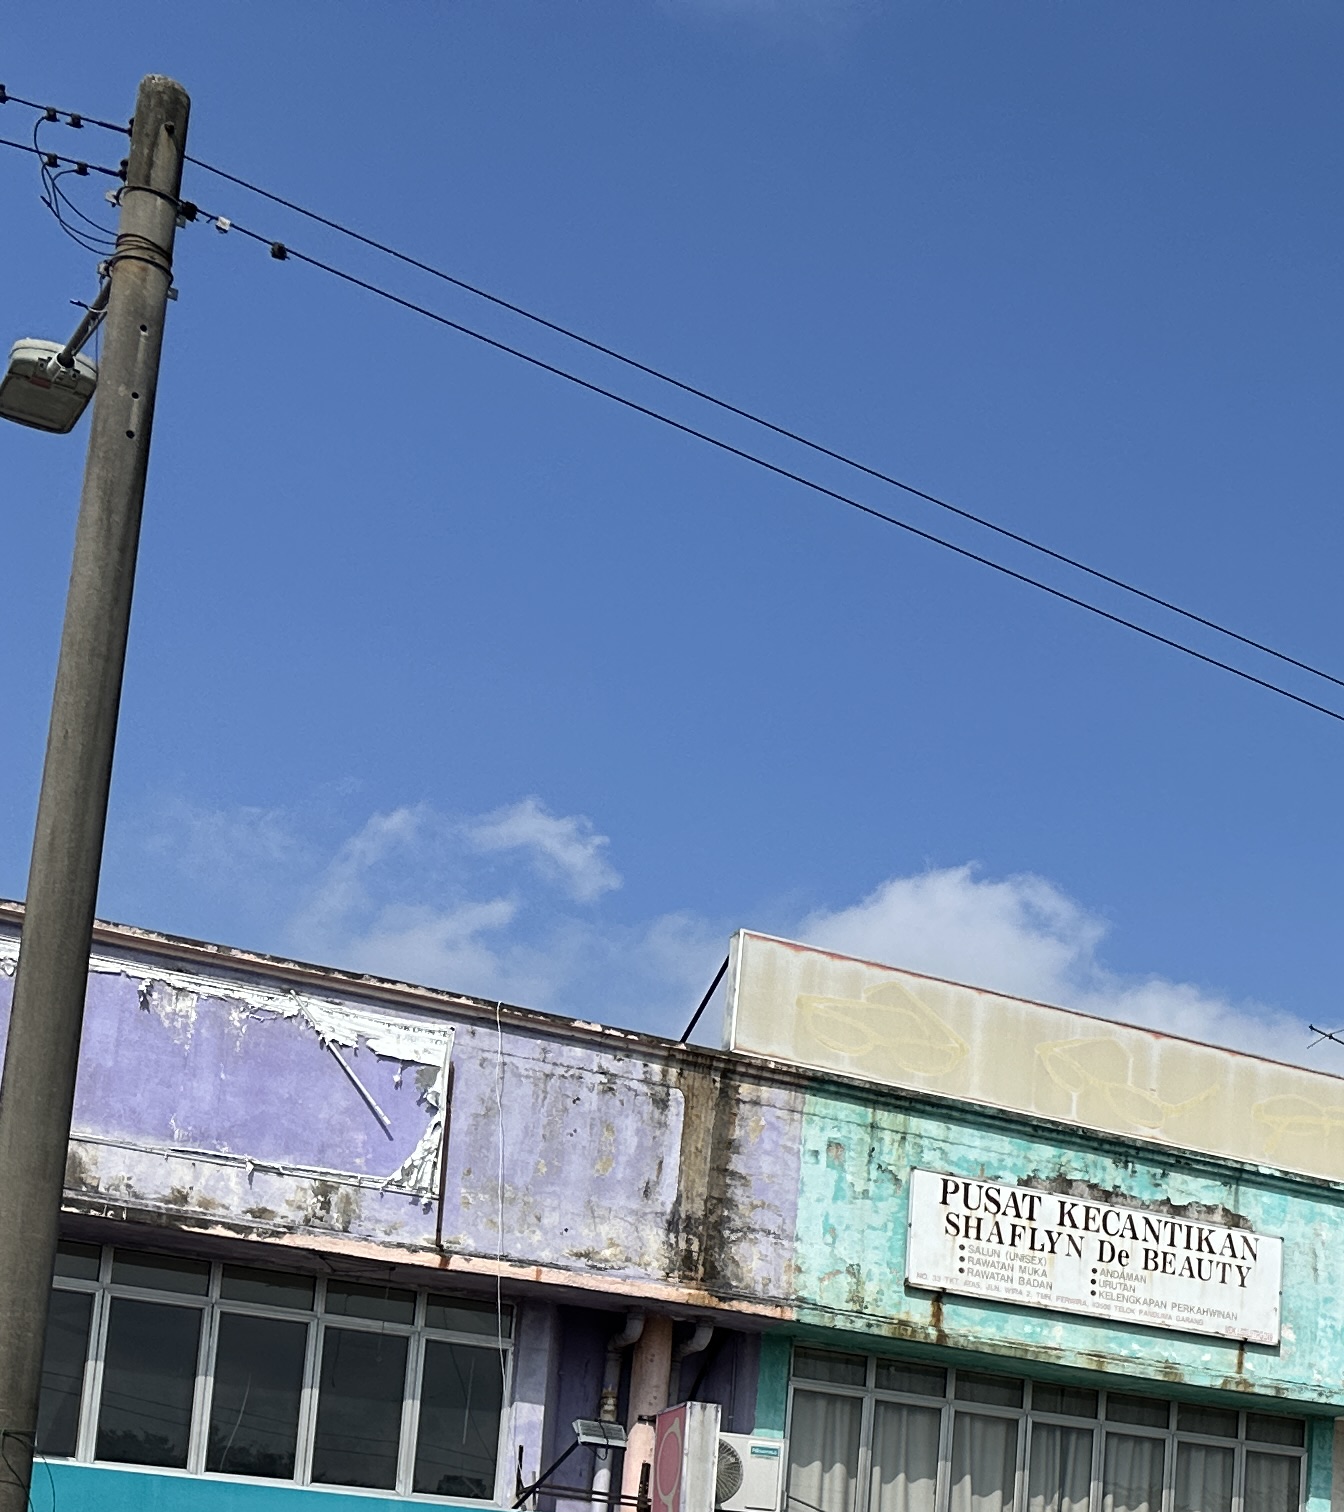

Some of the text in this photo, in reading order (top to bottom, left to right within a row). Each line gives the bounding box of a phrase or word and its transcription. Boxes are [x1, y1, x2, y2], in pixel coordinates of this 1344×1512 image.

[939, 1178, 1260, 1262] PUSAT KECANTIKAN
[945, 1211, 1251, 1288] SHAFLYN De BEAUTY
[968, 1244, 1000, 1258] SALUN
[967, 1267, 1053, 1290] RAWATAN BADAN
[968, 1256, 1048, 1278] RAWATAN MUKA
[1099, 1279, 1136, 1293] URUTAN
[1099, 1290, 1238, 1321] KELENGKAPAN PERKAHWINAN
